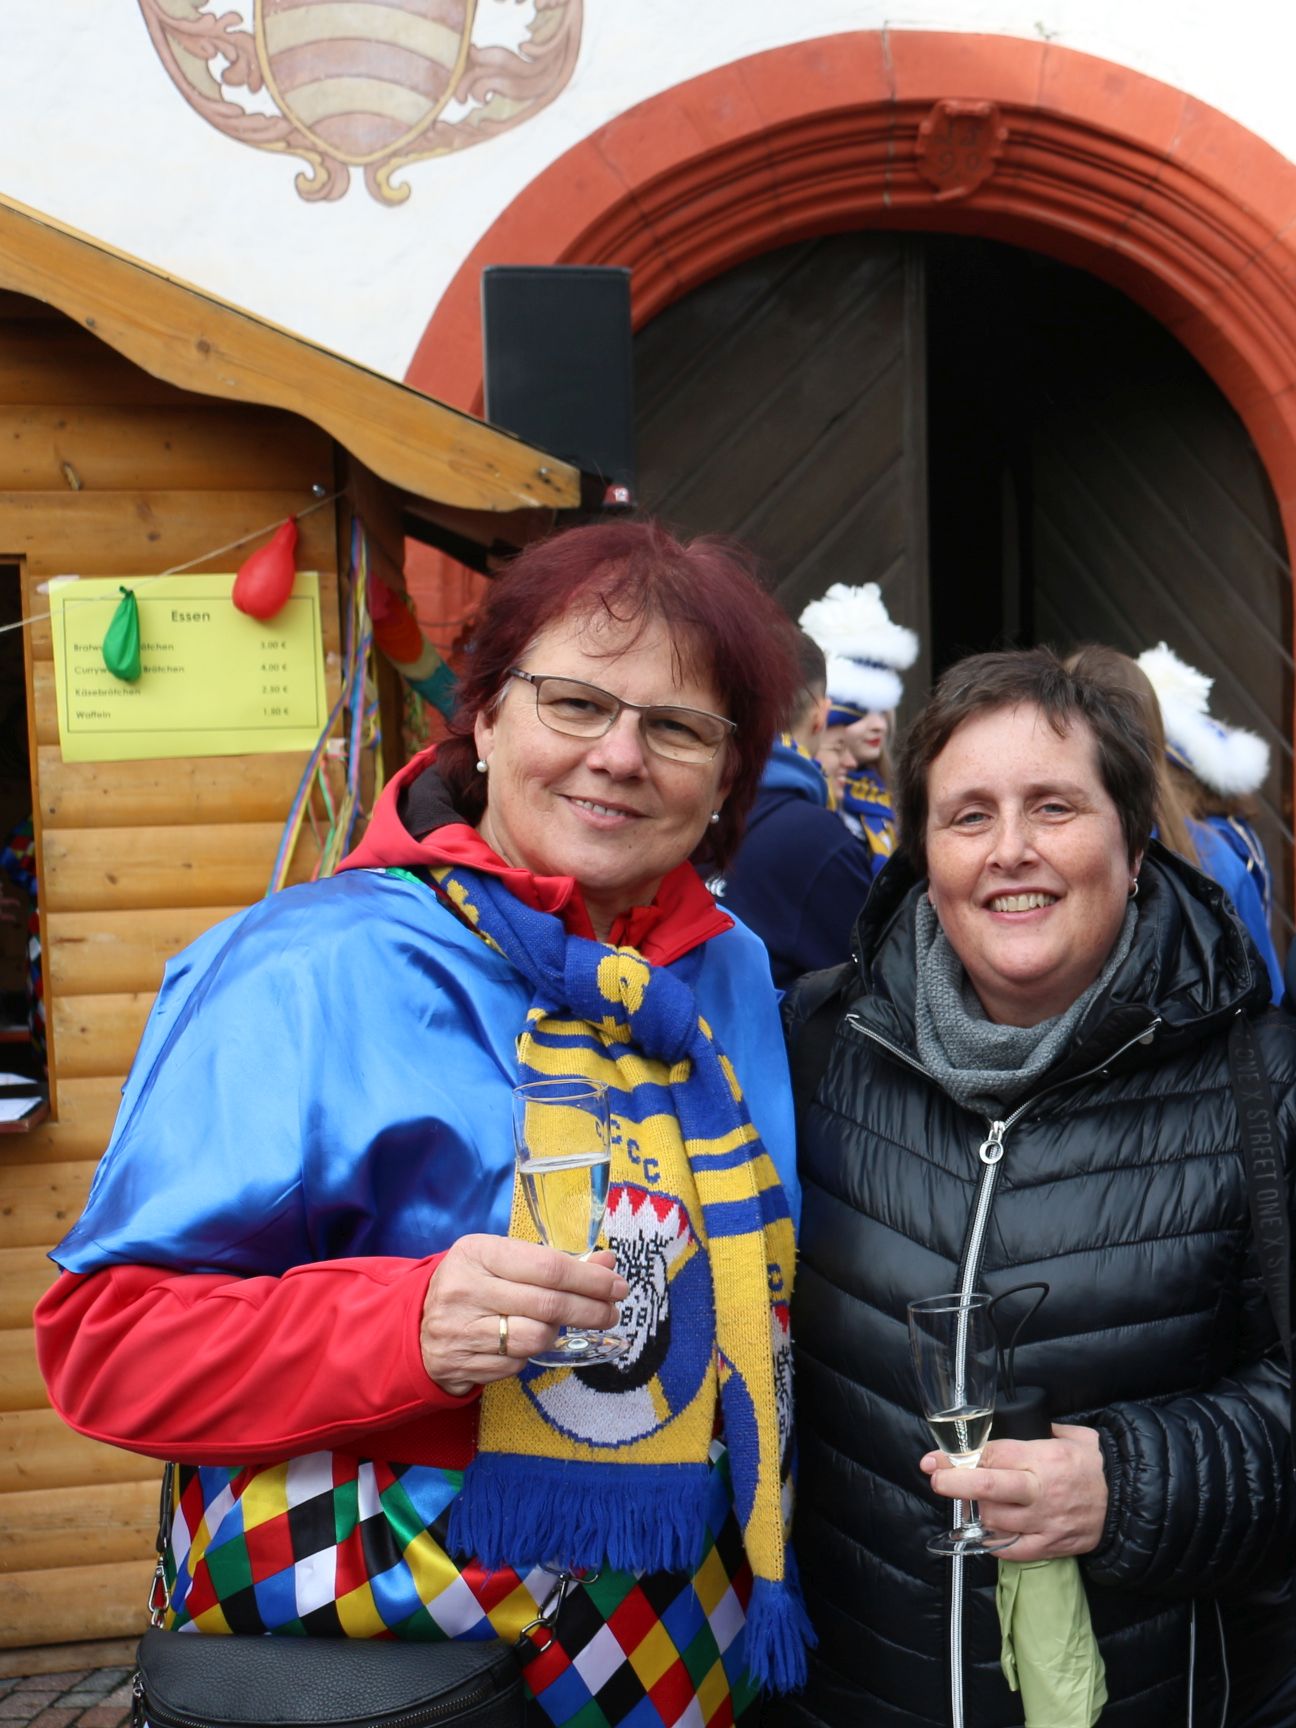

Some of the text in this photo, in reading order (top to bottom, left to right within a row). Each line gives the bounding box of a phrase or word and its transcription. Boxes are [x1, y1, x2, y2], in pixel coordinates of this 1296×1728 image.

[171, 609, 210, 622] Essen
[74, 665, 108, 675] Curryw
[143, 665, 185, 673] Brötchen
[75, 687, 141, 697] Käsebrötchen
[76, 709, 111, 719] Waffeln
[1246, 1109, 1278, 1180] STREET
[1256, 1188, 1283, 1228] ONE
